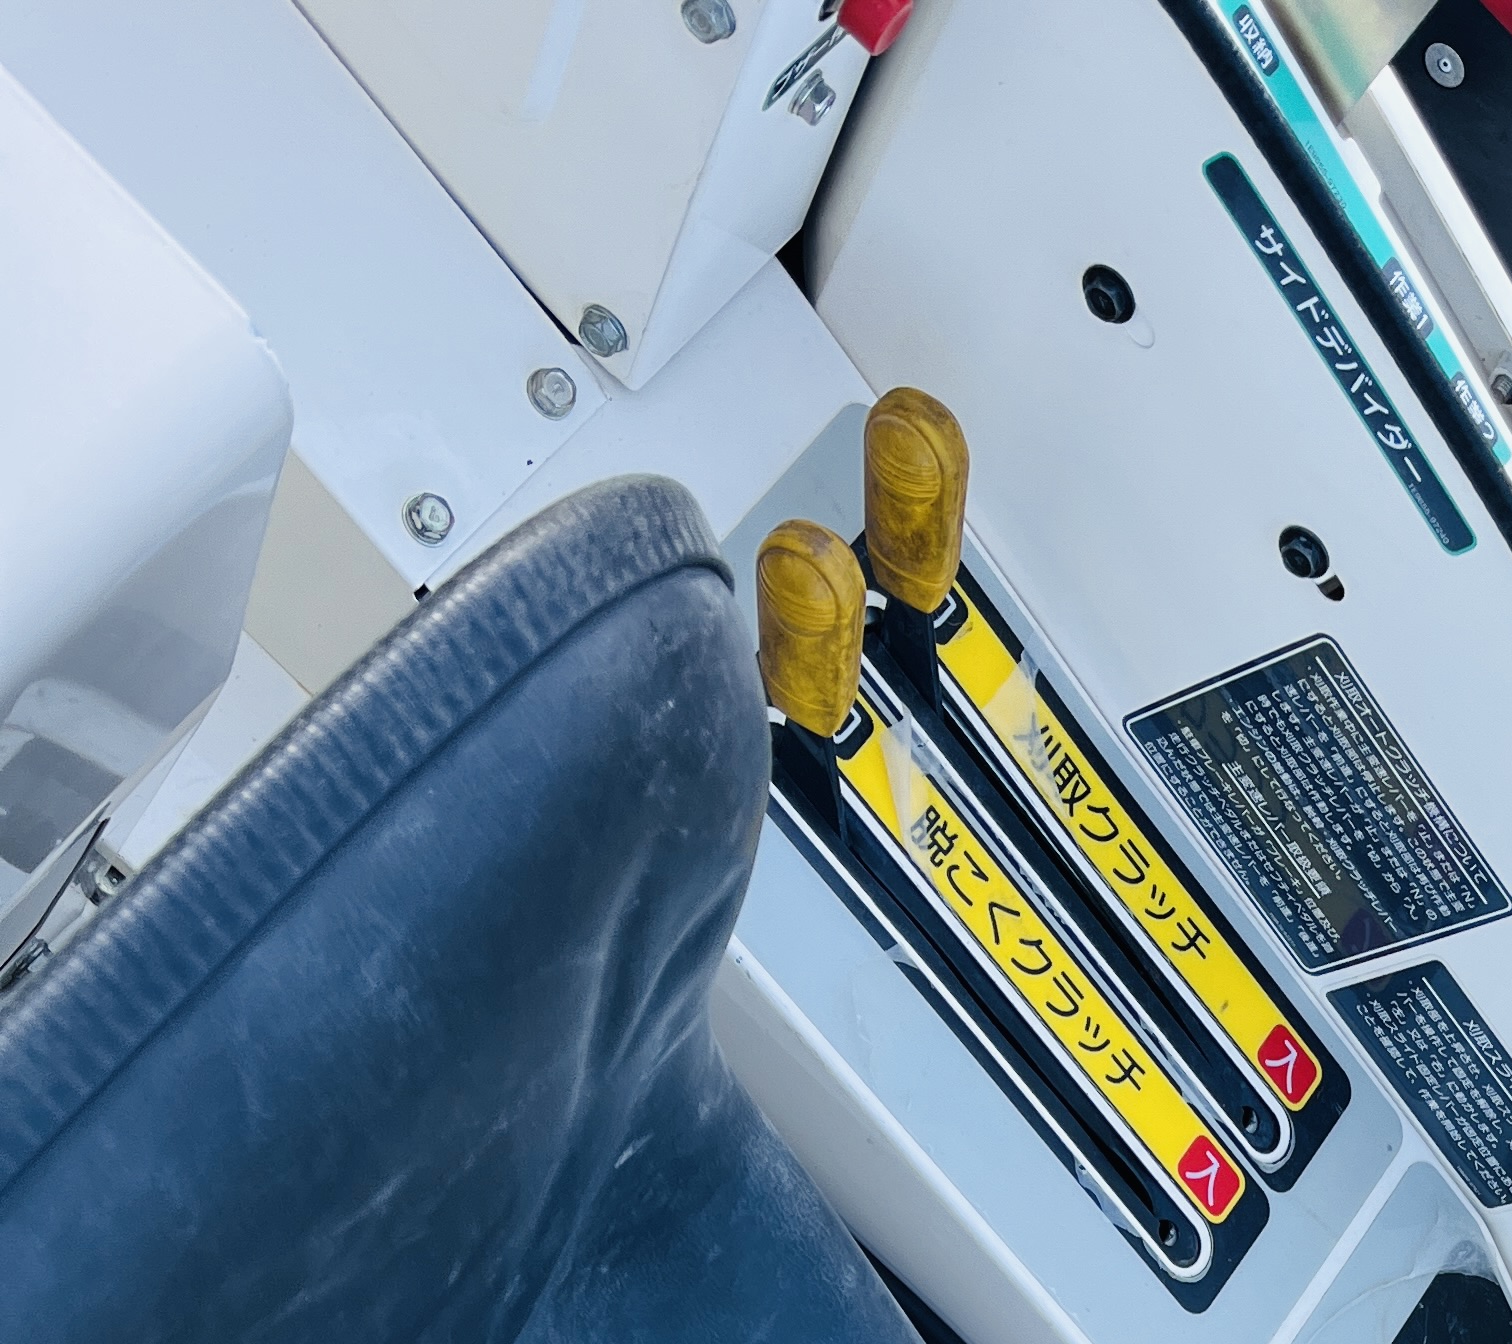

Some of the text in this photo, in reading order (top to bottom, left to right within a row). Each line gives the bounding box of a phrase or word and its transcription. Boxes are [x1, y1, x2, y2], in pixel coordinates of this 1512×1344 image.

[1234, 11, 1278, 69] 収納
[1248, 221, 1431, 488] サイドデバイダー
[1385, 268, 1432, 331] 作業1
[1009, 711, 1218, 970] 刈取クラッチ
[1333, 668, 1487, 886] 刈取オートクラッチ機構について
[902, 804, 1153, 1103] 脱こくクラッチ
[1260, 1040, 1315, 1095] 入
[1180, 1150, 1237, 1207] 入
